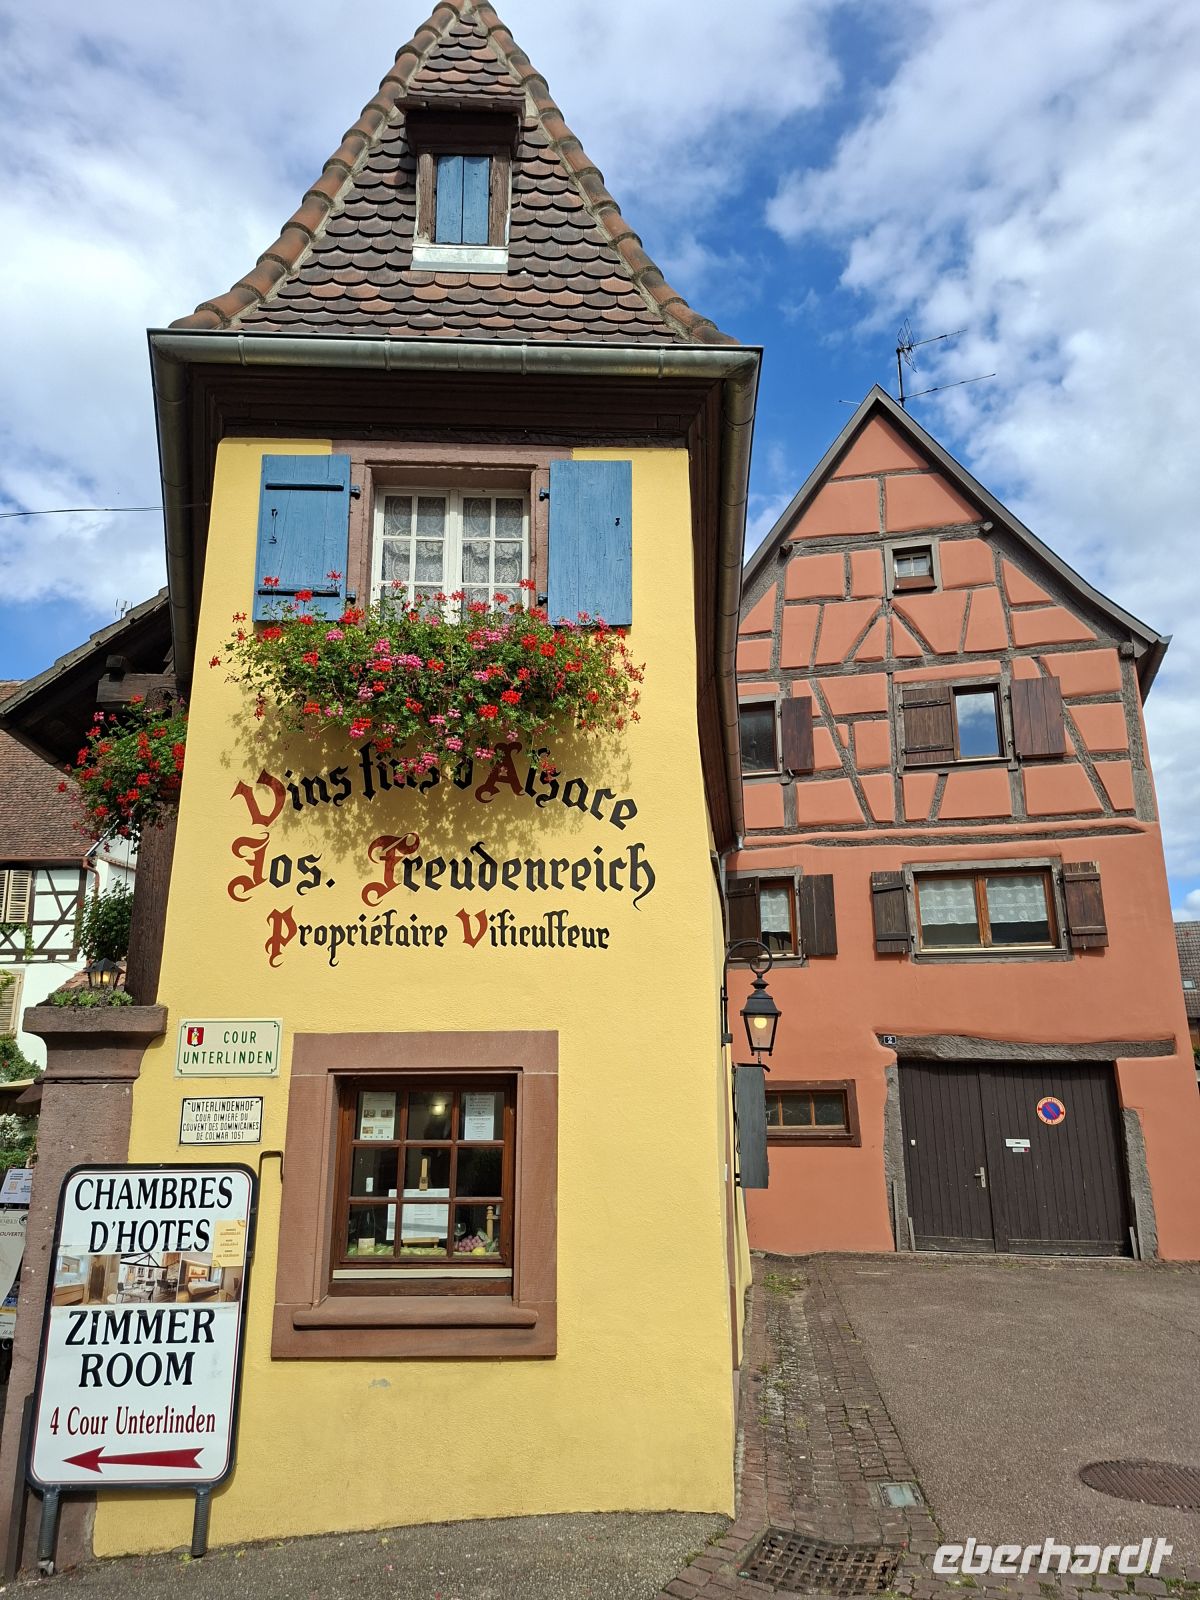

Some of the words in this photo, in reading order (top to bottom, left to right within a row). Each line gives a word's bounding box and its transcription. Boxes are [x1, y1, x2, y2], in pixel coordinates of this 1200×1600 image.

[230, 765, 352, 827] Vins
[228, 832, 336, 902] Jos.
[361, 832, 656, 911] Freudenreich
[265, 906, 448, 968] Propriétaire
[455, 907, 610, 950] Viticulteur
[223, 1030, 257, 1044] COUR
[183, 1051, 273, 1064] UNTERLINDEN
[191, 1100, 254, 1112] UNTERLINDENHOF
[182, 1122, 207, 1132] COUVENT
[208, 1122, 219, 1131] DES
[196, 1132, 203, 1140] DE
[205, 1131, 229, 1140] COLMAR
[74, 1176, 233, 1211] CHAMBRES
[87, 1219, 210, 1253] D'HOTES
[65, 1308, 215, 1345] ZIMMER
[78, 1351, 195, 1387] ROOM
[50, 1406, 60, 1435] 4
[67, 1406, 108, 1435] Cour
[116, 1405, 216, 1434] Unterlinden
